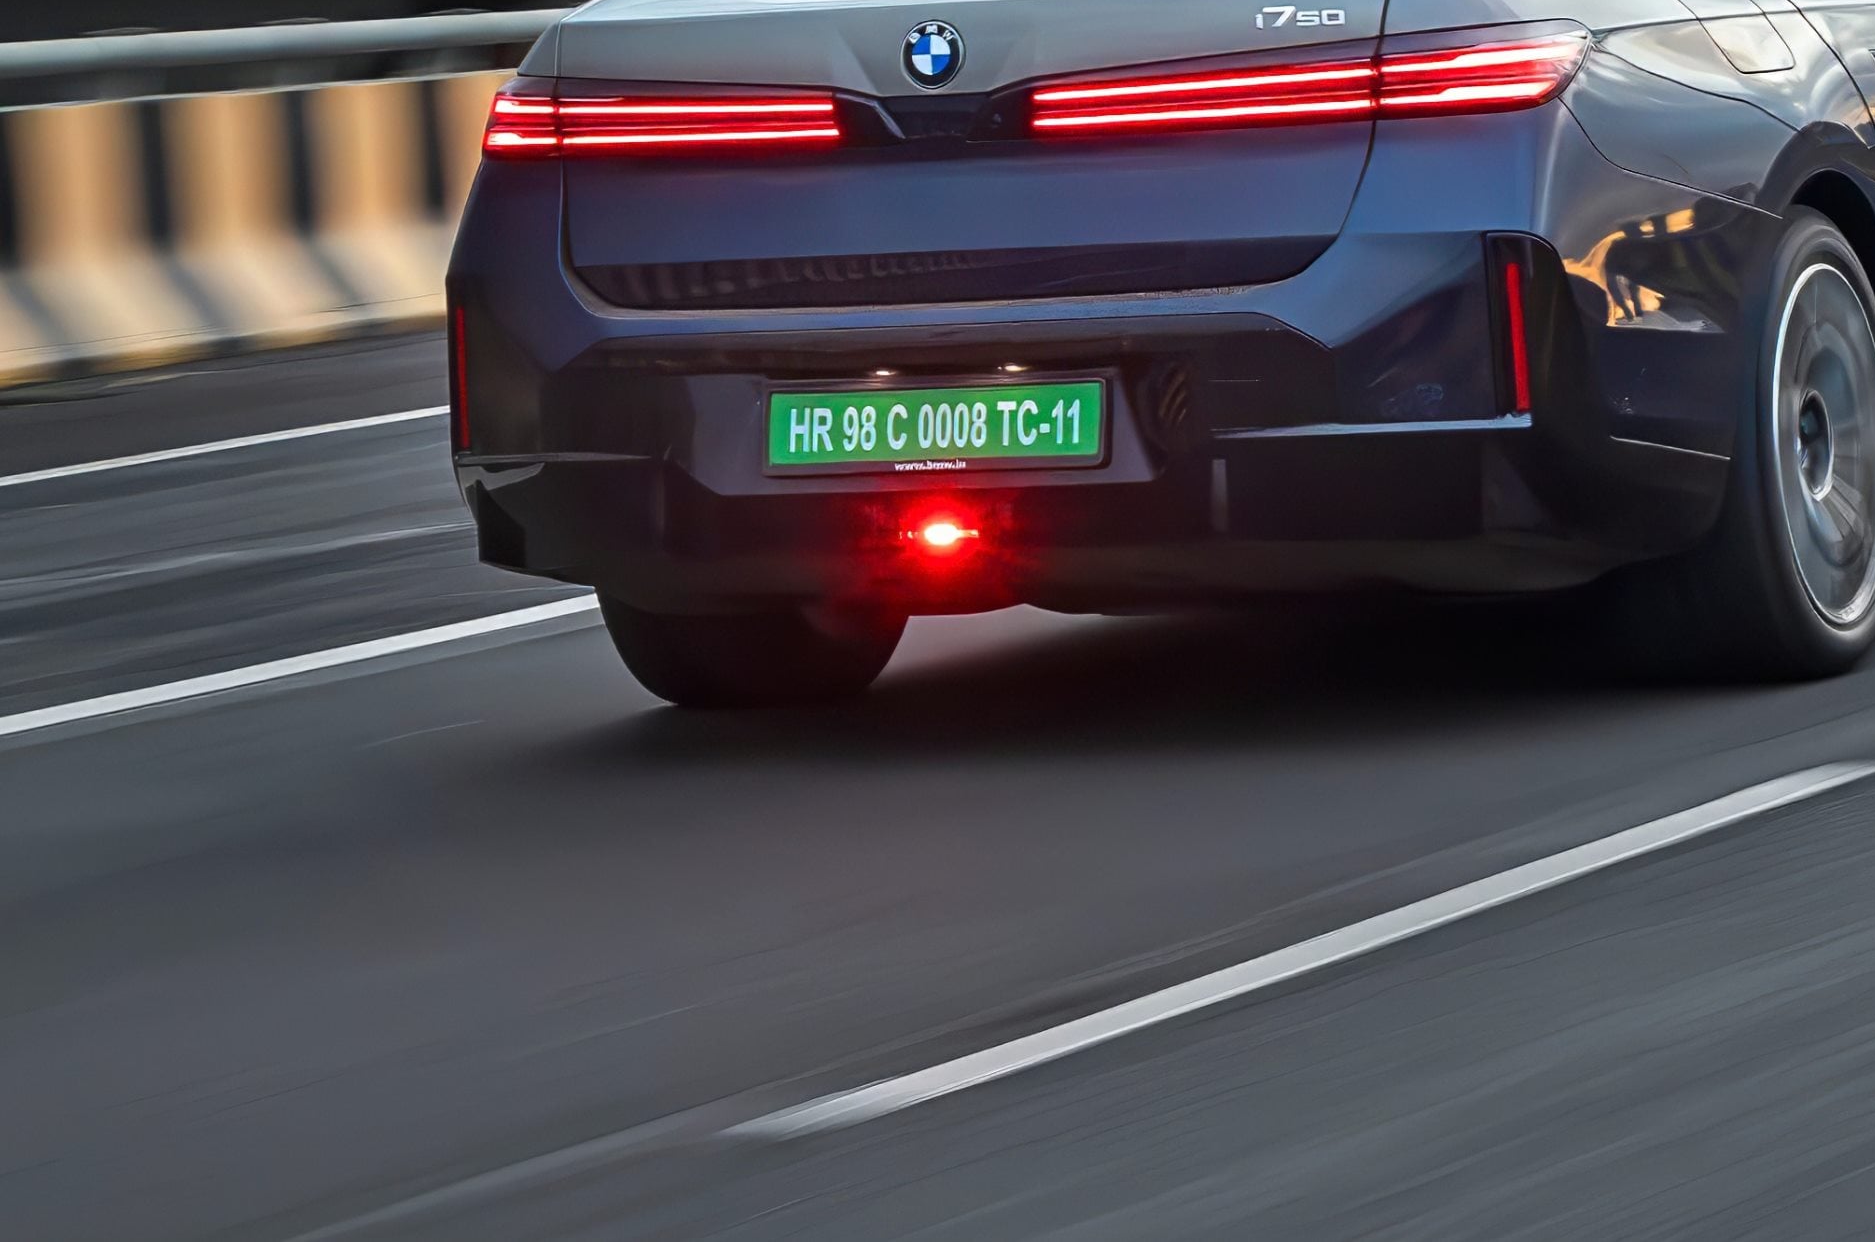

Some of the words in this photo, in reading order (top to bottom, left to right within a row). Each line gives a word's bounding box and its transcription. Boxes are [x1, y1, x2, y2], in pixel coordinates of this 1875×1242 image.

[1255, 5, 1345, 30] i750
[908, 23, 957, 45] BMW
[789, 407, 834, 453] HR
[843, 405, 877, 452] 98
[886, 403, 908, 451] C
[917, 401, 988, 449] 0008
[996, 398, 1081, 446] TC-11
